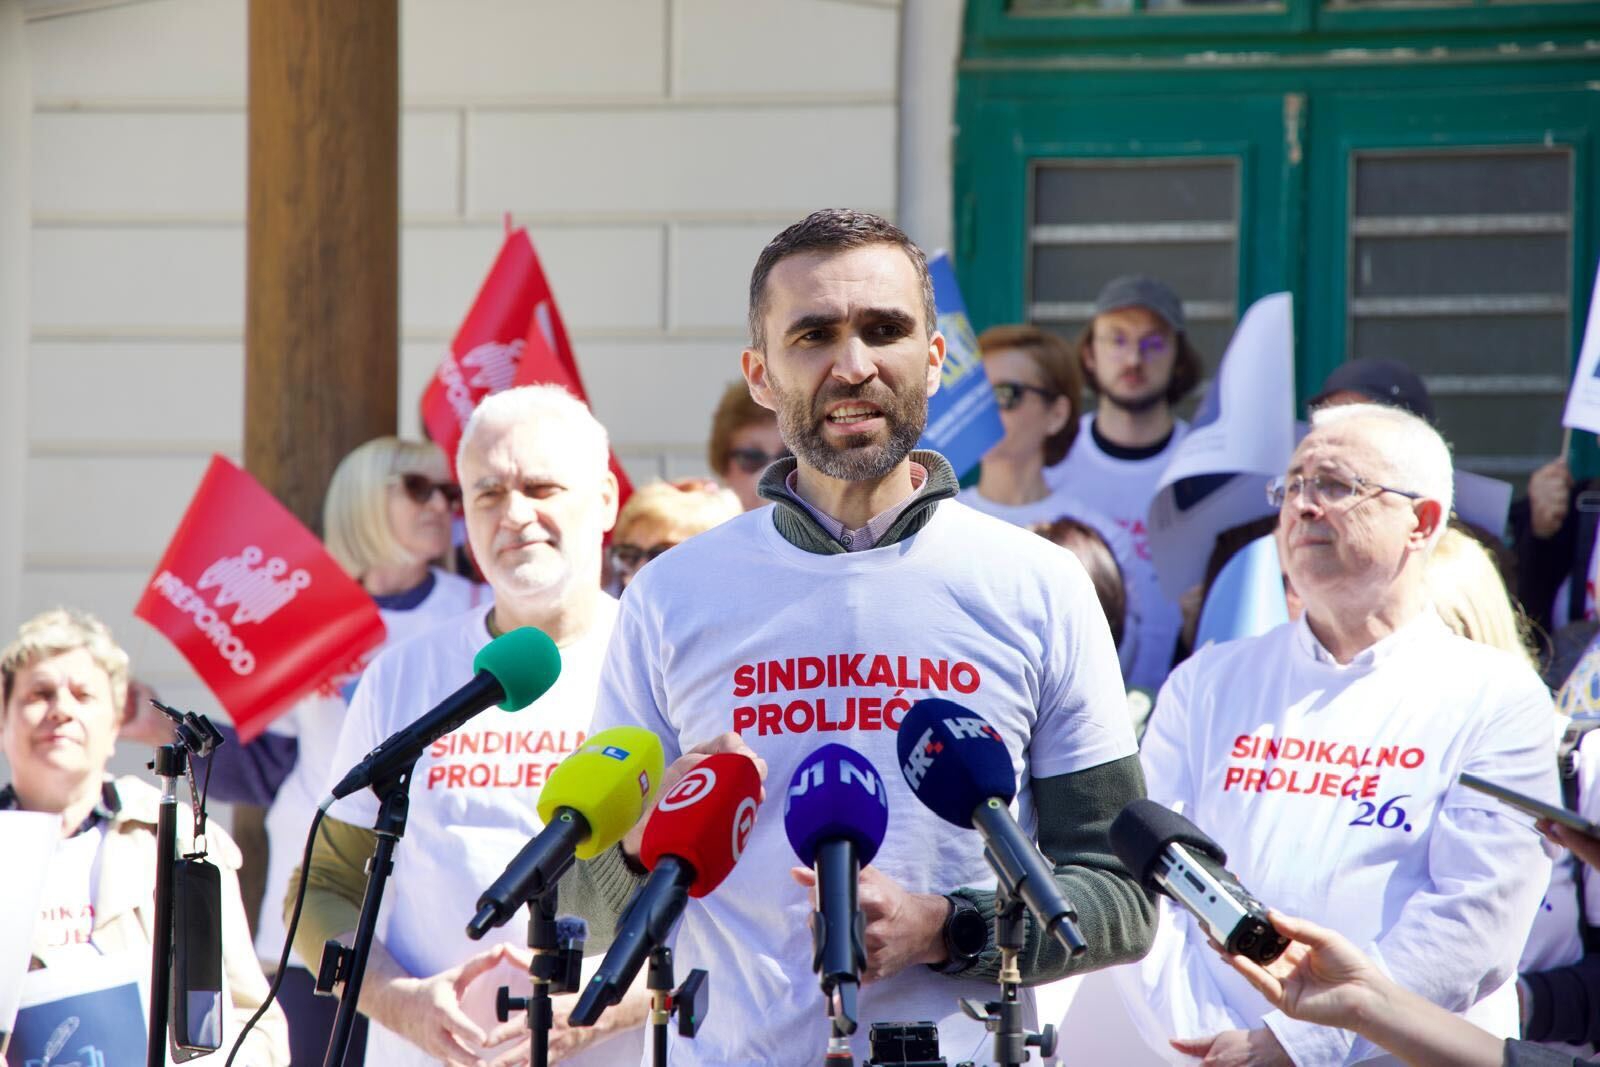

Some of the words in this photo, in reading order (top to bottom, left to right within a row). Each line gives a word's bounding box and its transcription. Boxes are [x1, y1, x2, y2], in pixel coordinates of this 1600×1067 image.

[733, 653, 981, 697] SINDIKALNO
[733, 690, 921, 736] PROLJEĆ
[1231, 735, 1425, 769] SINDIKALNO
